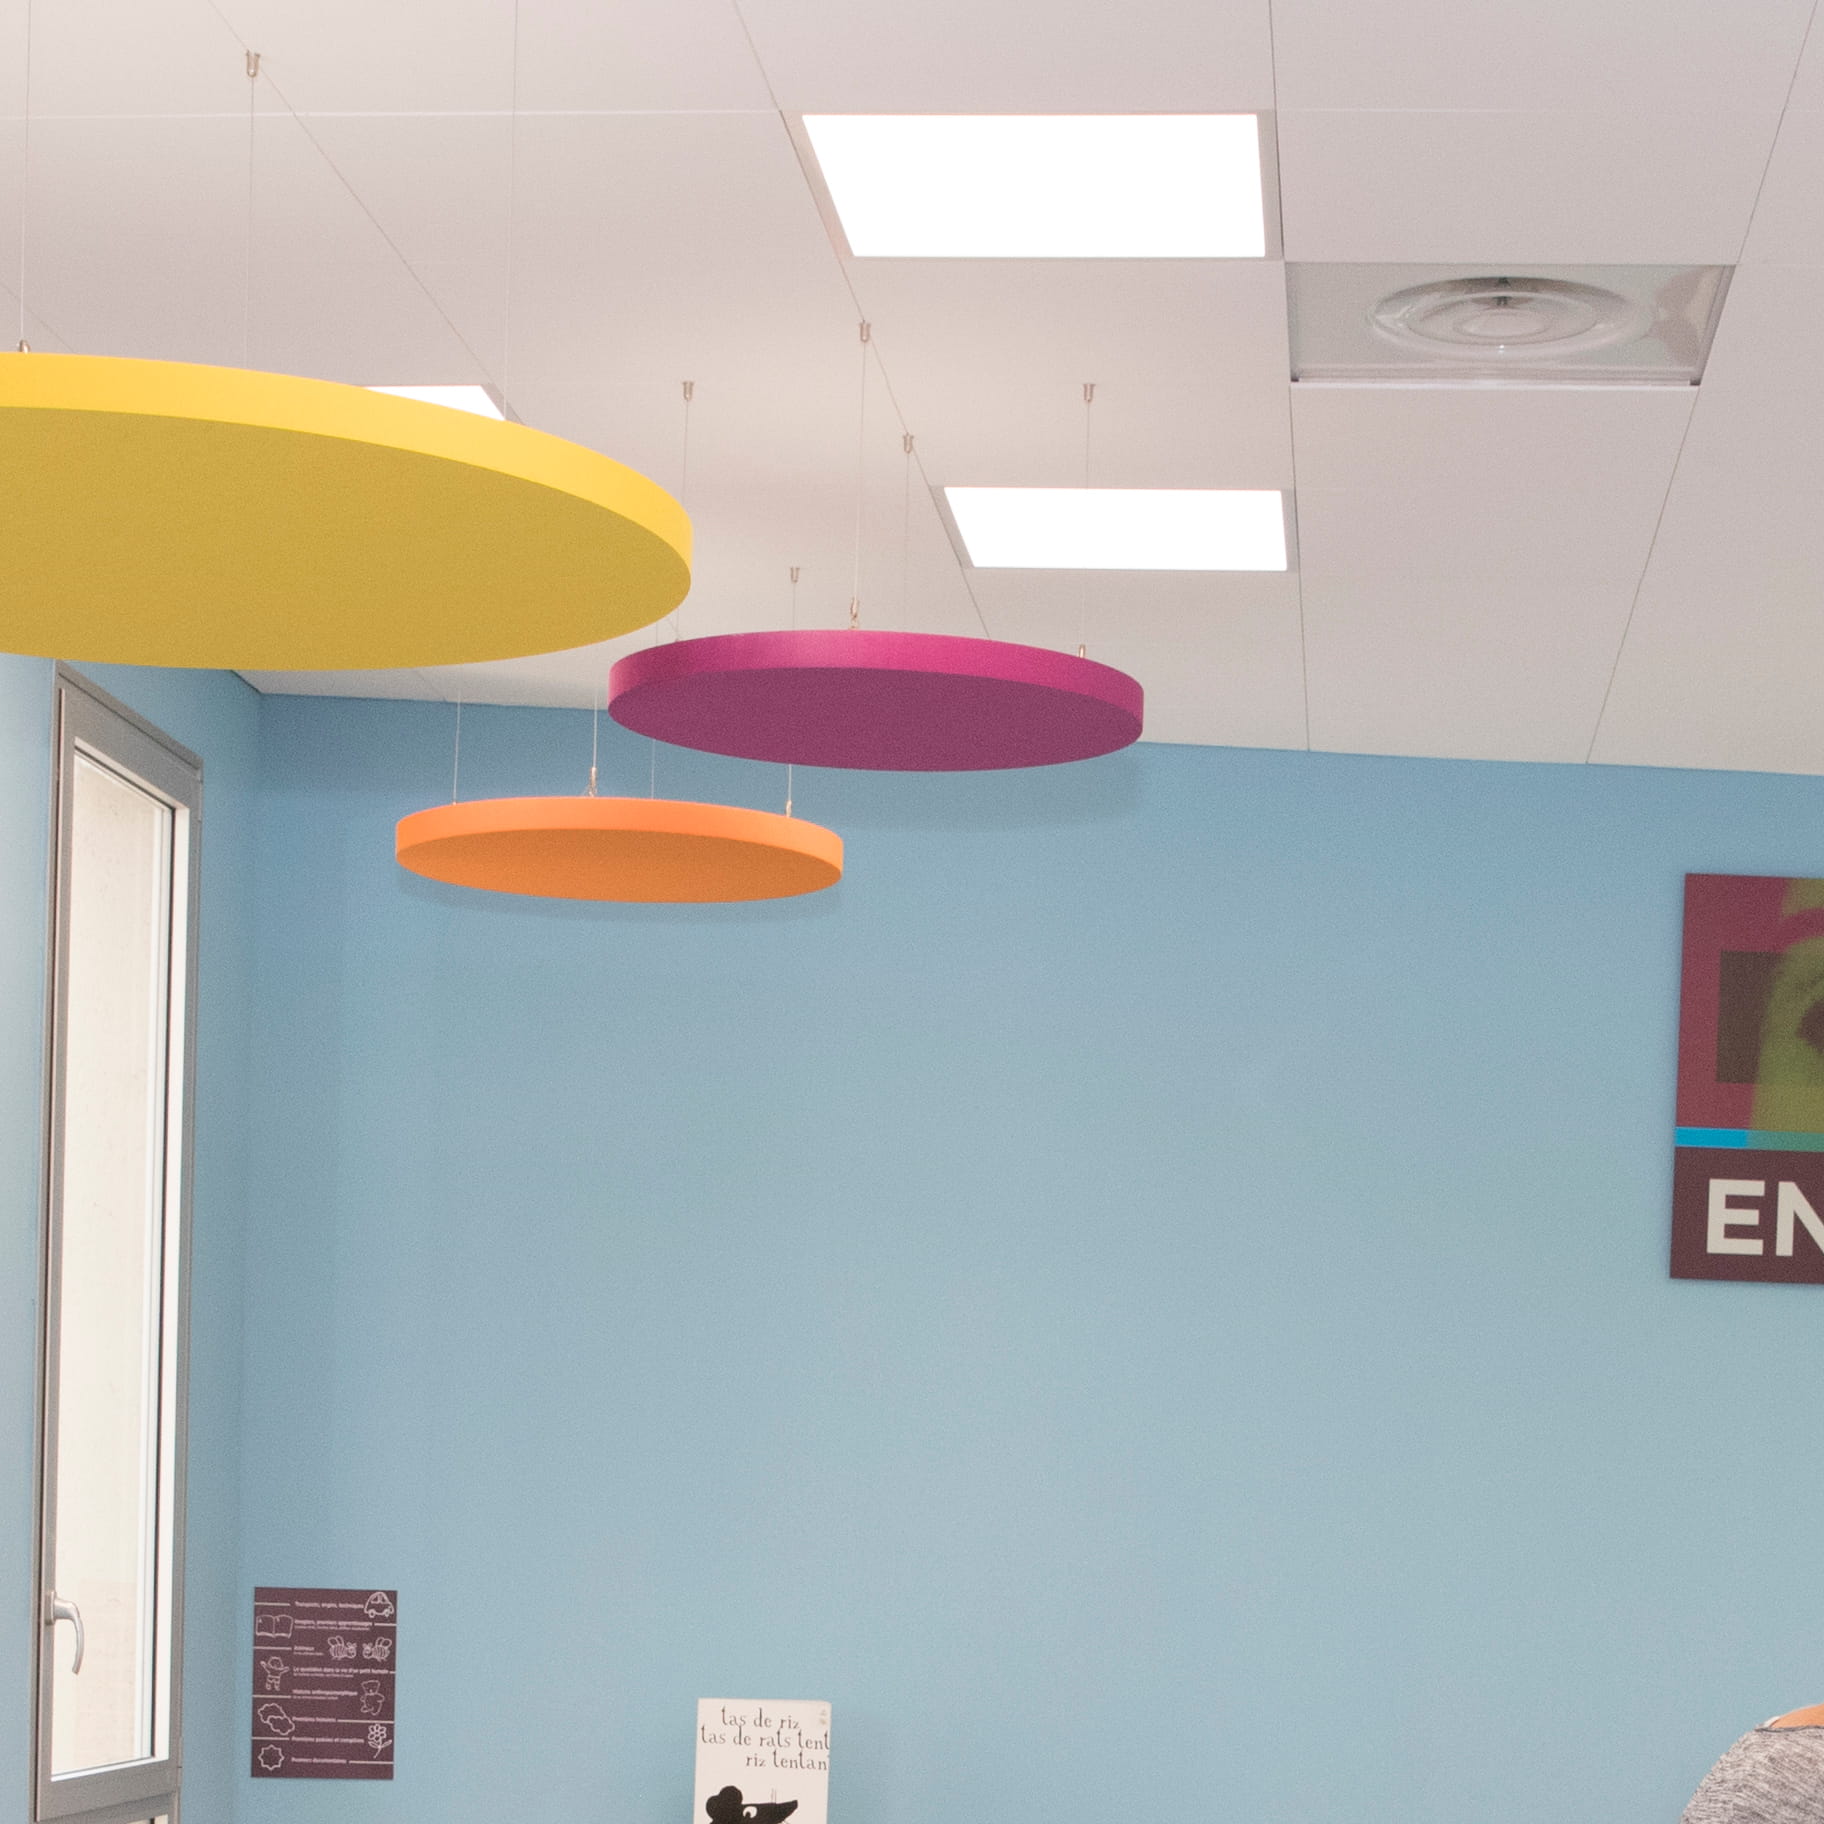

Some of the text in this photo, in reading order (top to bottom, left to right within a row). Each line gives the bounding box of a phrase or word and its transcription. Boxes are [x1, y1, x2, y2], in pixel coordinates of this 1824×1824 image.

[721, 1706, 800, 1729] tas de riz
[701, 1725, 726, 1744] tas
[733, 1725, 751, 1746] de
[759, 1730, 791, 1748] rats
[746, 1753, 766, 1767] riz
